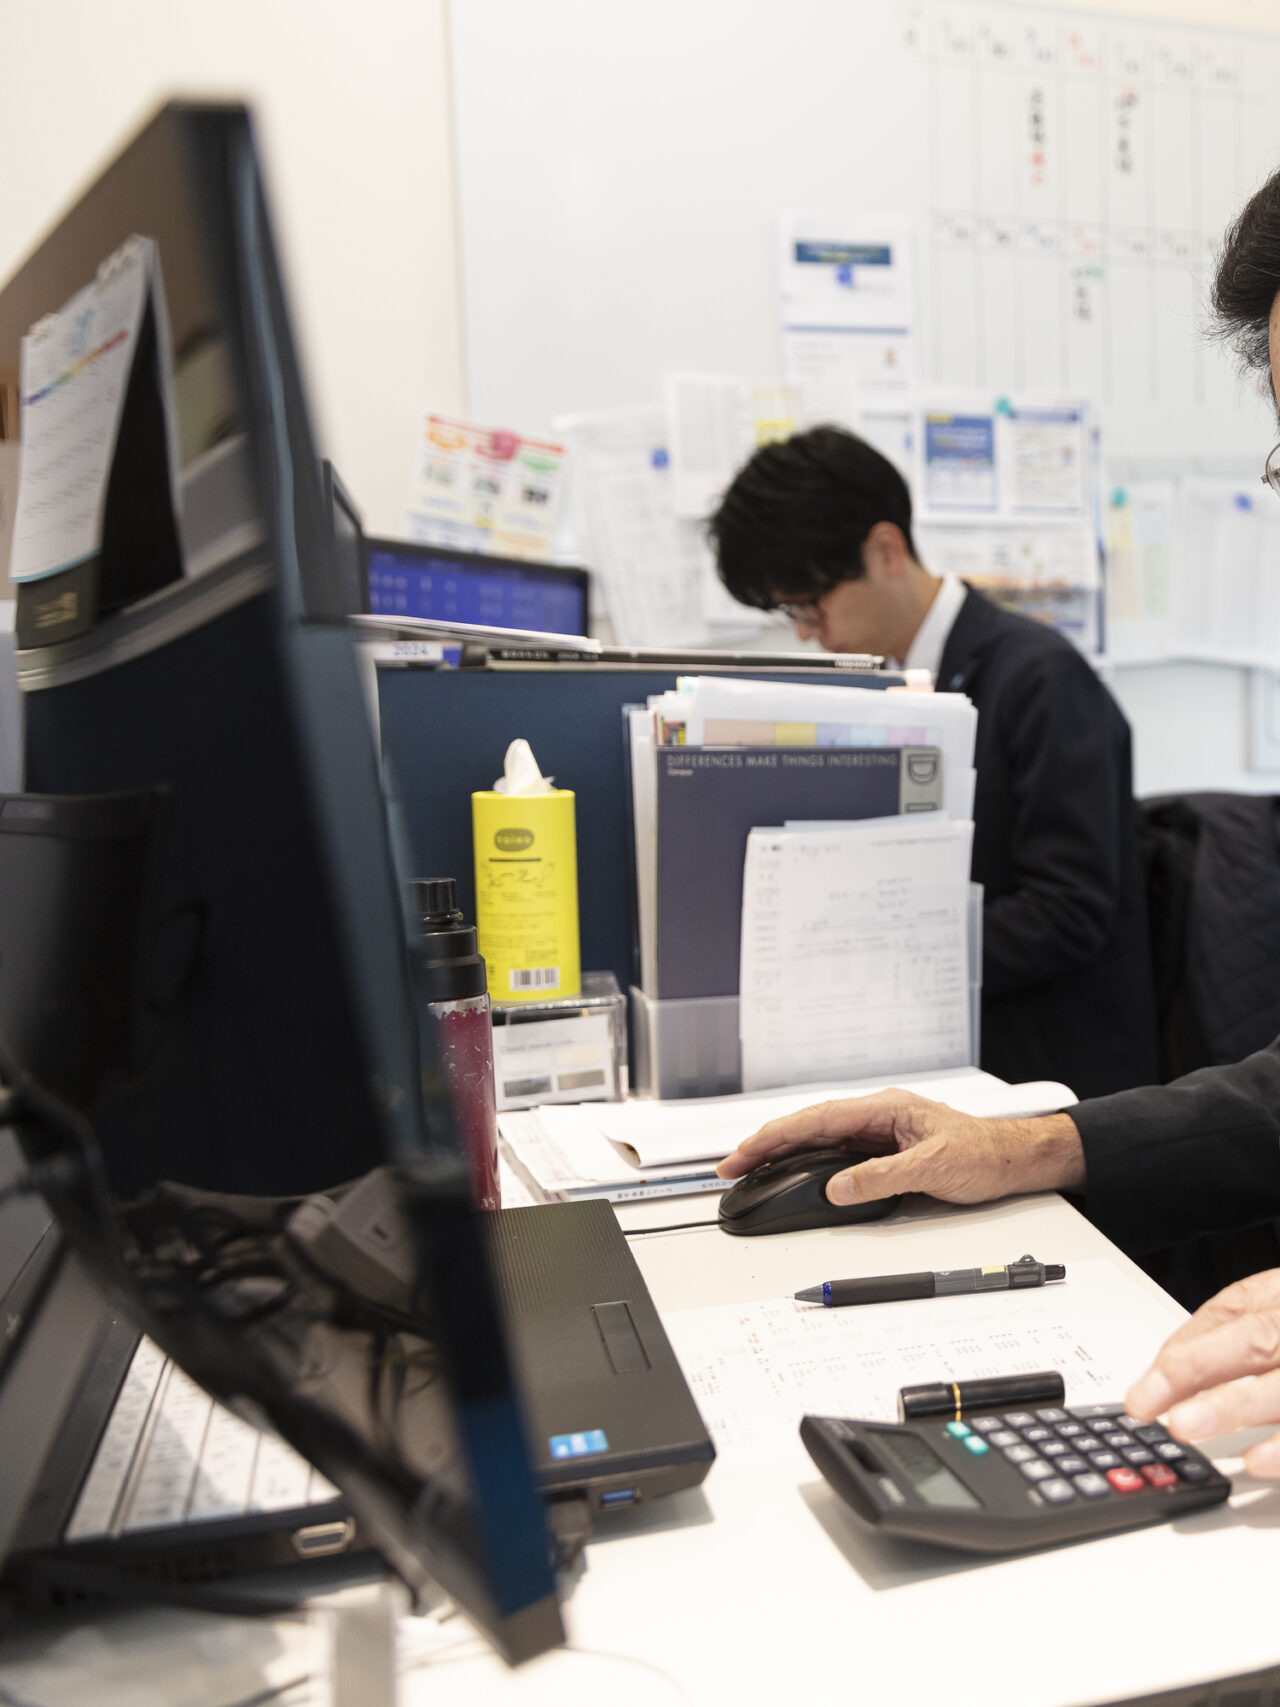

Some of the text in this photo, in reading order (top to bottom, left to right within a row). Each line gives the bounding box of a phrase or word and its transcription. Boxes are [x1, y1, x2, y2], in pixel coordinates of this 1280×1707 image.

[667, 752, 898, 769] DIFFERENCES MAKE THINGS INTERESTING
